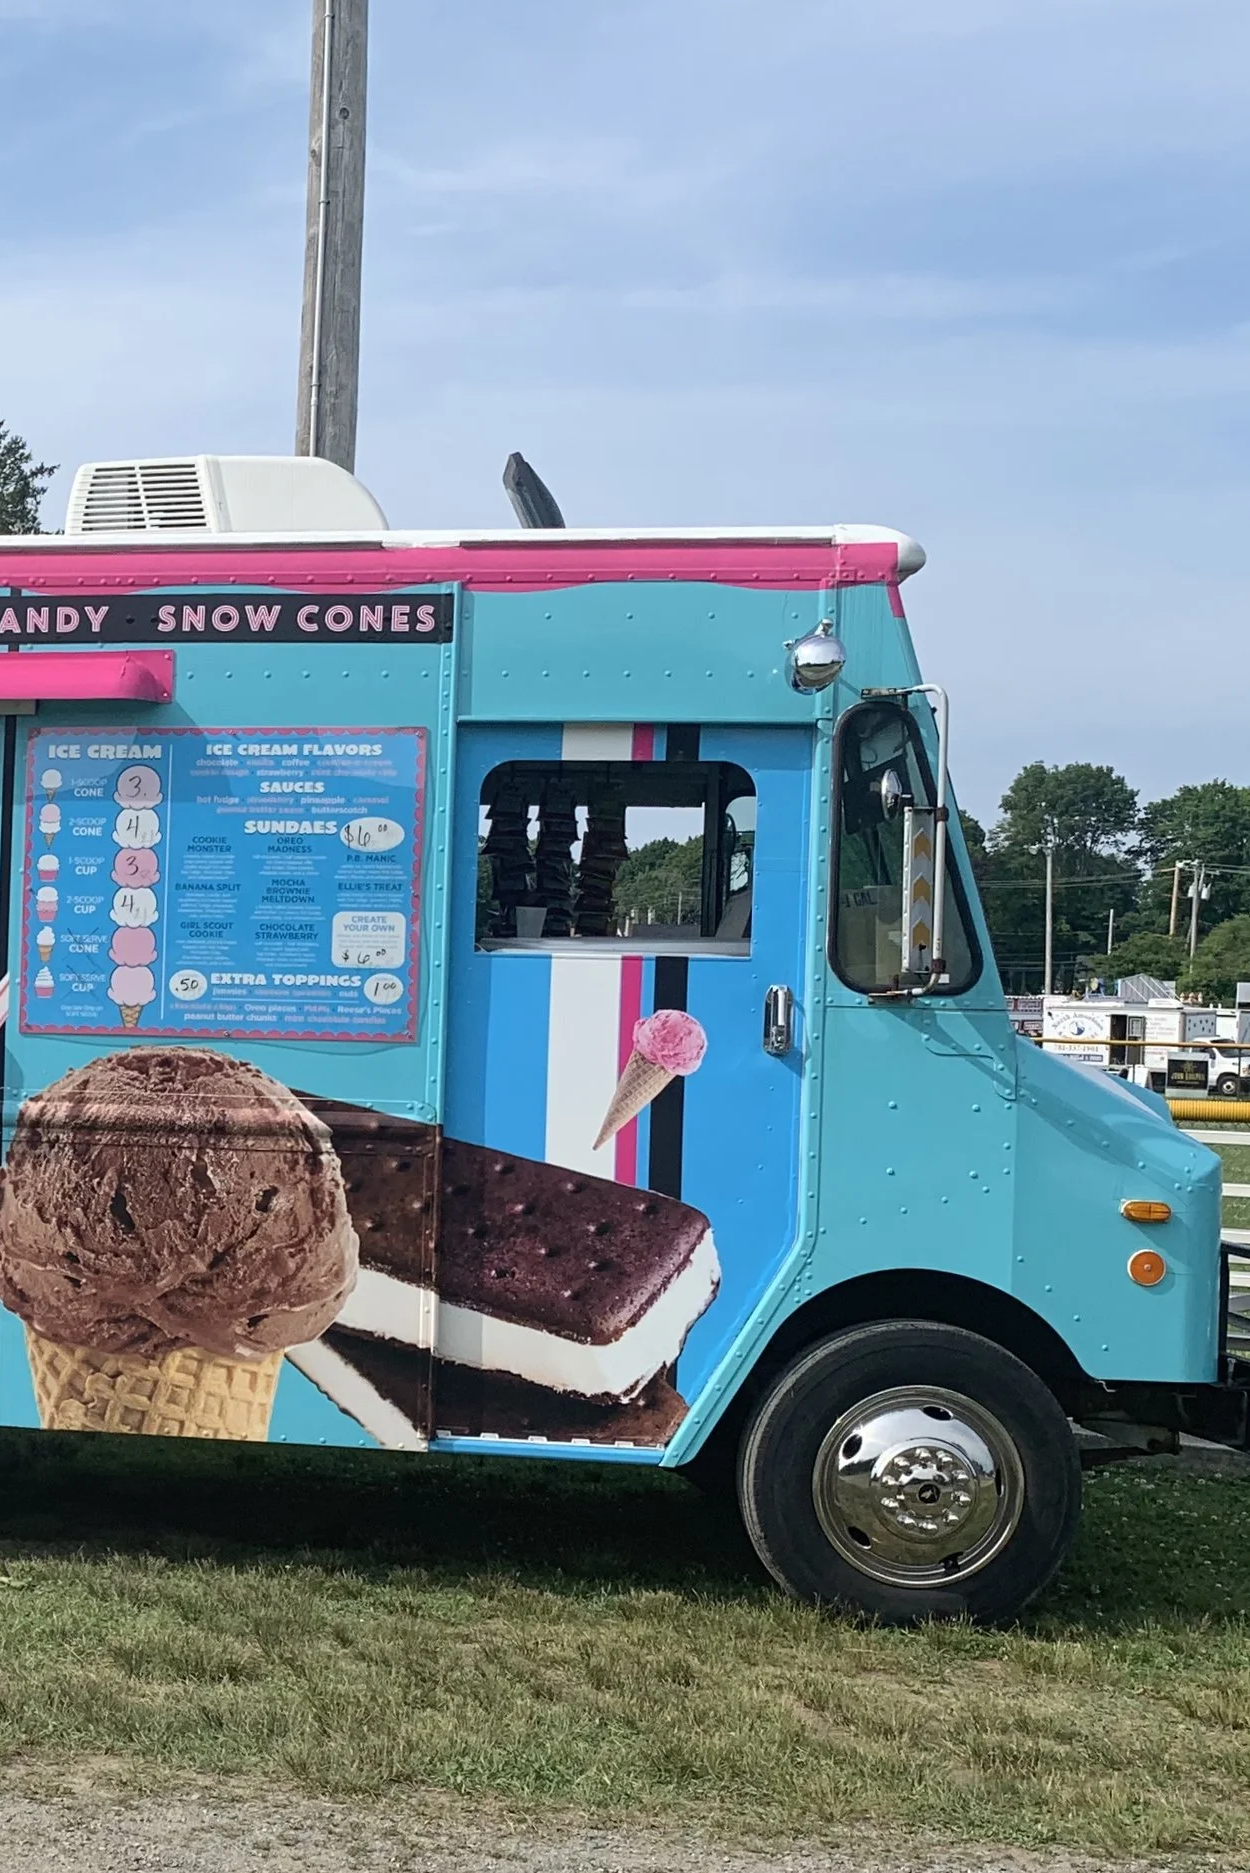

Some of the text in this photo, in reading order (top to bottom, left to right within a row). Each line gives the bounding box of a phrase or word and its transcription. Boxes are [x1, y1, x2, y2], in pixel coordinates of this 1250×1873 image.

[157, 604, 435, 633] SNOW CONES
[48, 744, 162, 760] ICE CREAM
[206, 744, 382, 757] ICE CREAM FLAVORS
[196, 758, 310, 767] chocolate coffee
[257, 769, 304, 778] strawberry
[259, 781, 325, 794] SAUCES
[74, 788, 104, 797] CONE
[196, 795, 211, 804] hot
[213, 795, 239, 805] fudge
[301, 796, 345, 805] pineapple
[311, 806, 368, 814] butterscotch
[69, 817, 107, 826] 2-SCOOP
[72, 827, 102, 836] CONE
[126, 815, 139, 839] 4
[244, 820, 337, 835] SUNDAES
[192, 836, 228, 845] COOKIE
[276, 837, 303, 845] OREO
[187, 845, 232, 853] MONSTER
[267, 845, 312, 853] MADNESS
[365, 855, 397, 863] MANIC
[126, 855, 139, 876] 3
[75, 866, 97, 875] CUP
[175, 883, 242, 892] BANANA SPLIT
[266, 887, 310, 895] BROWNIE
[338, 882, 403, 892] ELLIE'S TREAT
[66, 896, 104, 904] 2-SCOOP
[121, 894, 134, 912] 4
[261, 895, 315, 903] MELTDOWN
[74, 905, 96, 914] CUP
[350, 916, 387, 924] CREATE
[180, 921, 234, 930] GIRL SCOUT
[259, 923, 315, 932] CHOCOLATE
[343, 924, 395, 932] YOUR OWN
[188, 930, 224, 938] COOKIE
[255, 931, 319, 940] STRAWBERRY
[69, 944, 99, 953] CONE
[210, 973, 362, 987] EXTRA TOPPINGS
[72, 983, 94, 992] CUP
[184, 1012, 214, 1021] peanut
[217, 1013, 244, 1021] butter
